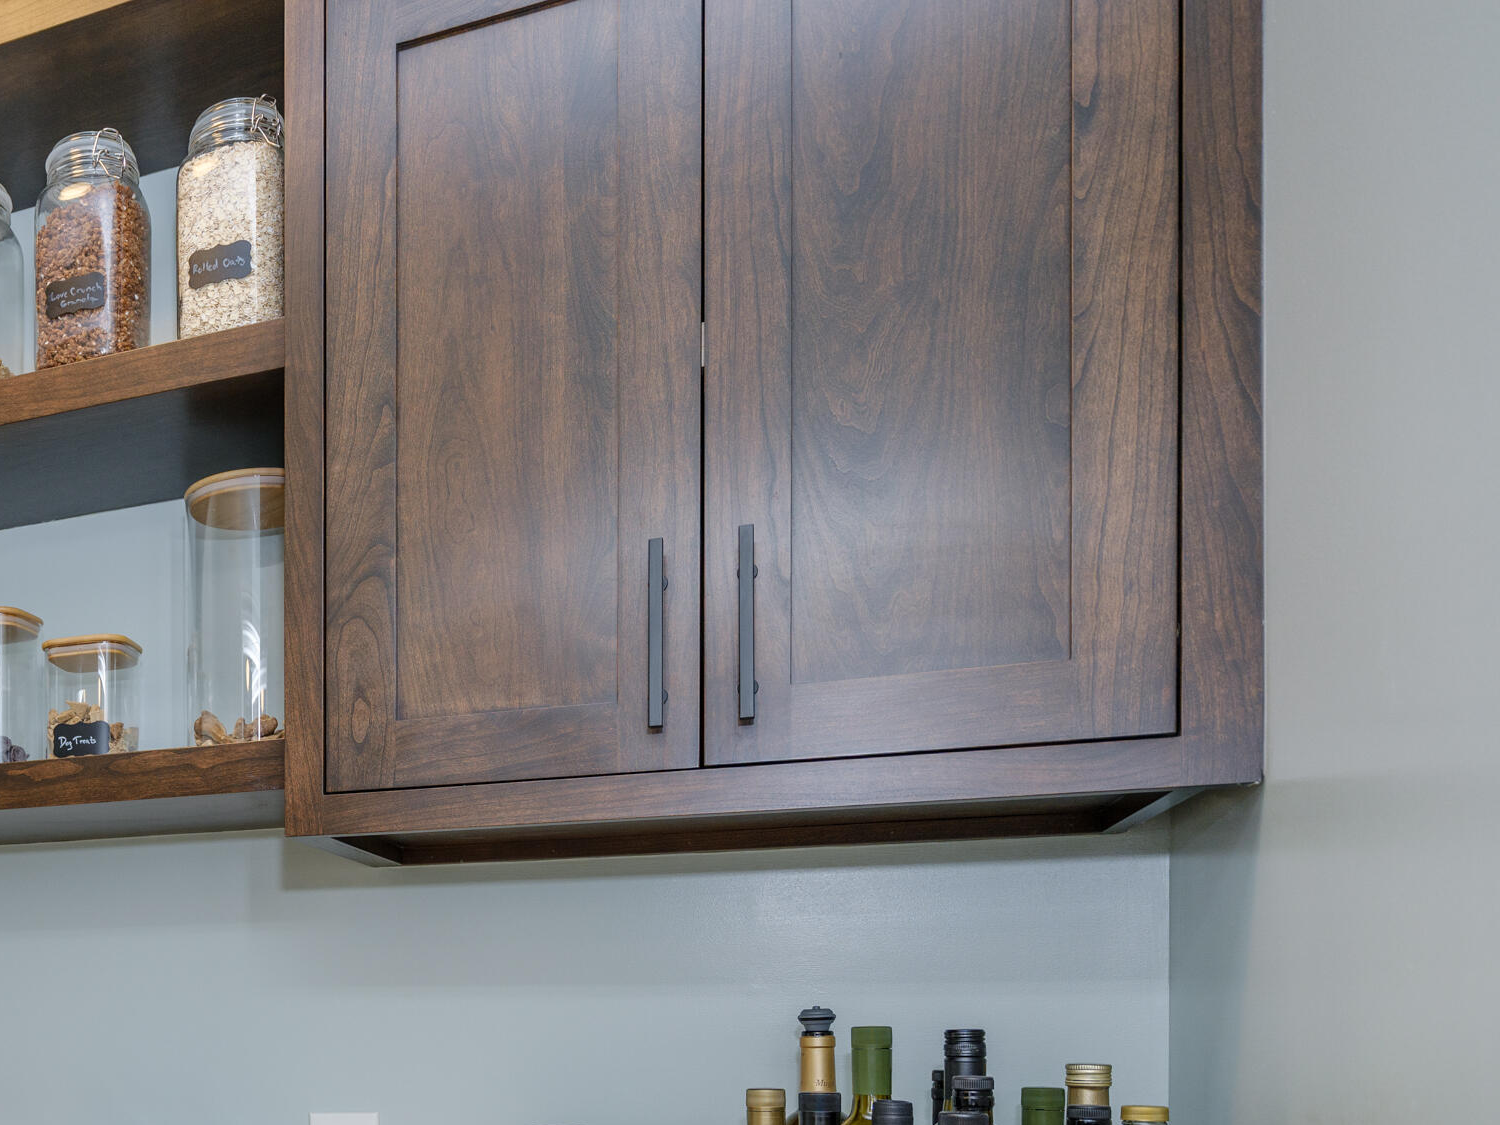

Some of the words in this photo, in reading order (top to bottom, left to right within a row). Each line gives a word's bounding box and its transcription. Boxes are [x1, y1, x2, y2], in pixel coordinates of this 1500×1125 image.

[192, 258, 219, 275] Rolled
[222, 255, 246, 268] Oats
[50, 291, 68, 302] Love
[70, 281, 102, 296] Crunch
[60, 293, 100, 308] Granola
[58, 735, 73, 751] Dog
[72, 735, 97, 745] Treats
